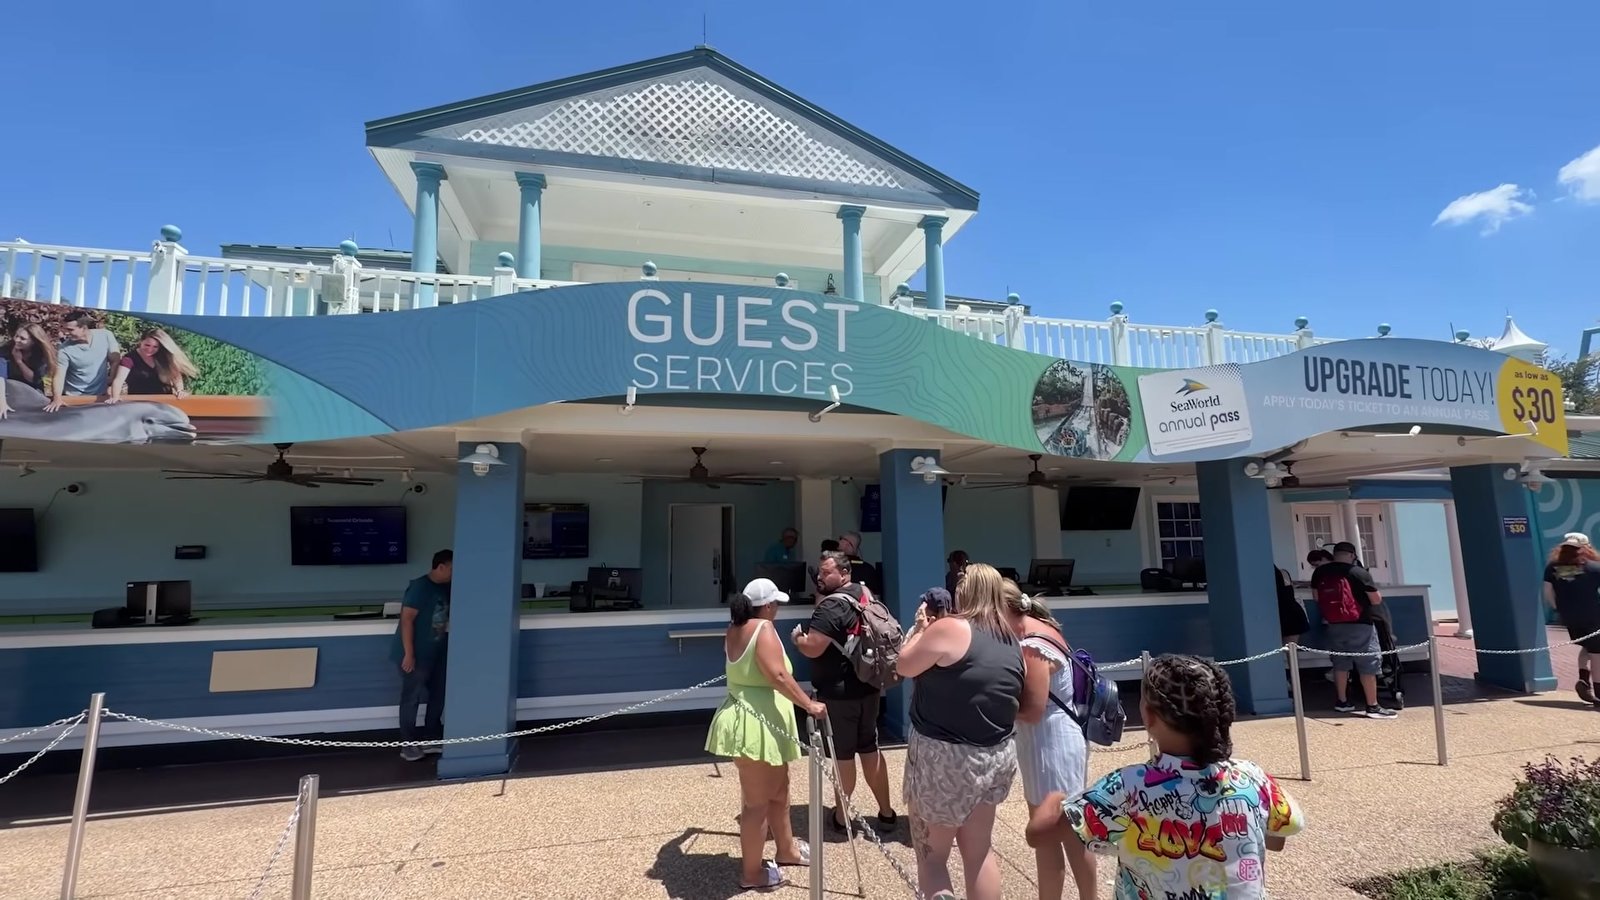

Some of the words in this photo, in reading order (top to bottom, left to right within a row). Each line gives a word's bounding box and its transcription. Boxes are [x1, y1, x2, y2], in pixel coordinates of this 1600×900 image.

[628, 289, 860, 353] GUEST
[632, 353, 854, 397] SERVICES
[1303, 355, 1413, 399] UPGRADE
[1416, 365, 1495, 405] TODAY!
[1525, 371, 1539, 380] low
[1540, 373, 1549, 381] as
[1170, 394, 1221, 413] SeaWorld
[1263, 395, 1296, 408] APPLY
[1300, 397, 1345, 412] TODAY'S
[1348, 400, 1384, 414] TICKET
[1386, 403, 1401, 415] TO
[1403, 404, 1419, 417] AN
[1420, 406, 1462, 420] ANNUAL
[1464, 408, 1490, 421] PASS
[1512, 386, 1556, 424] $30
[1159, 412, 1207, 433] annual
[1210, 410, 1240, 431] pass
